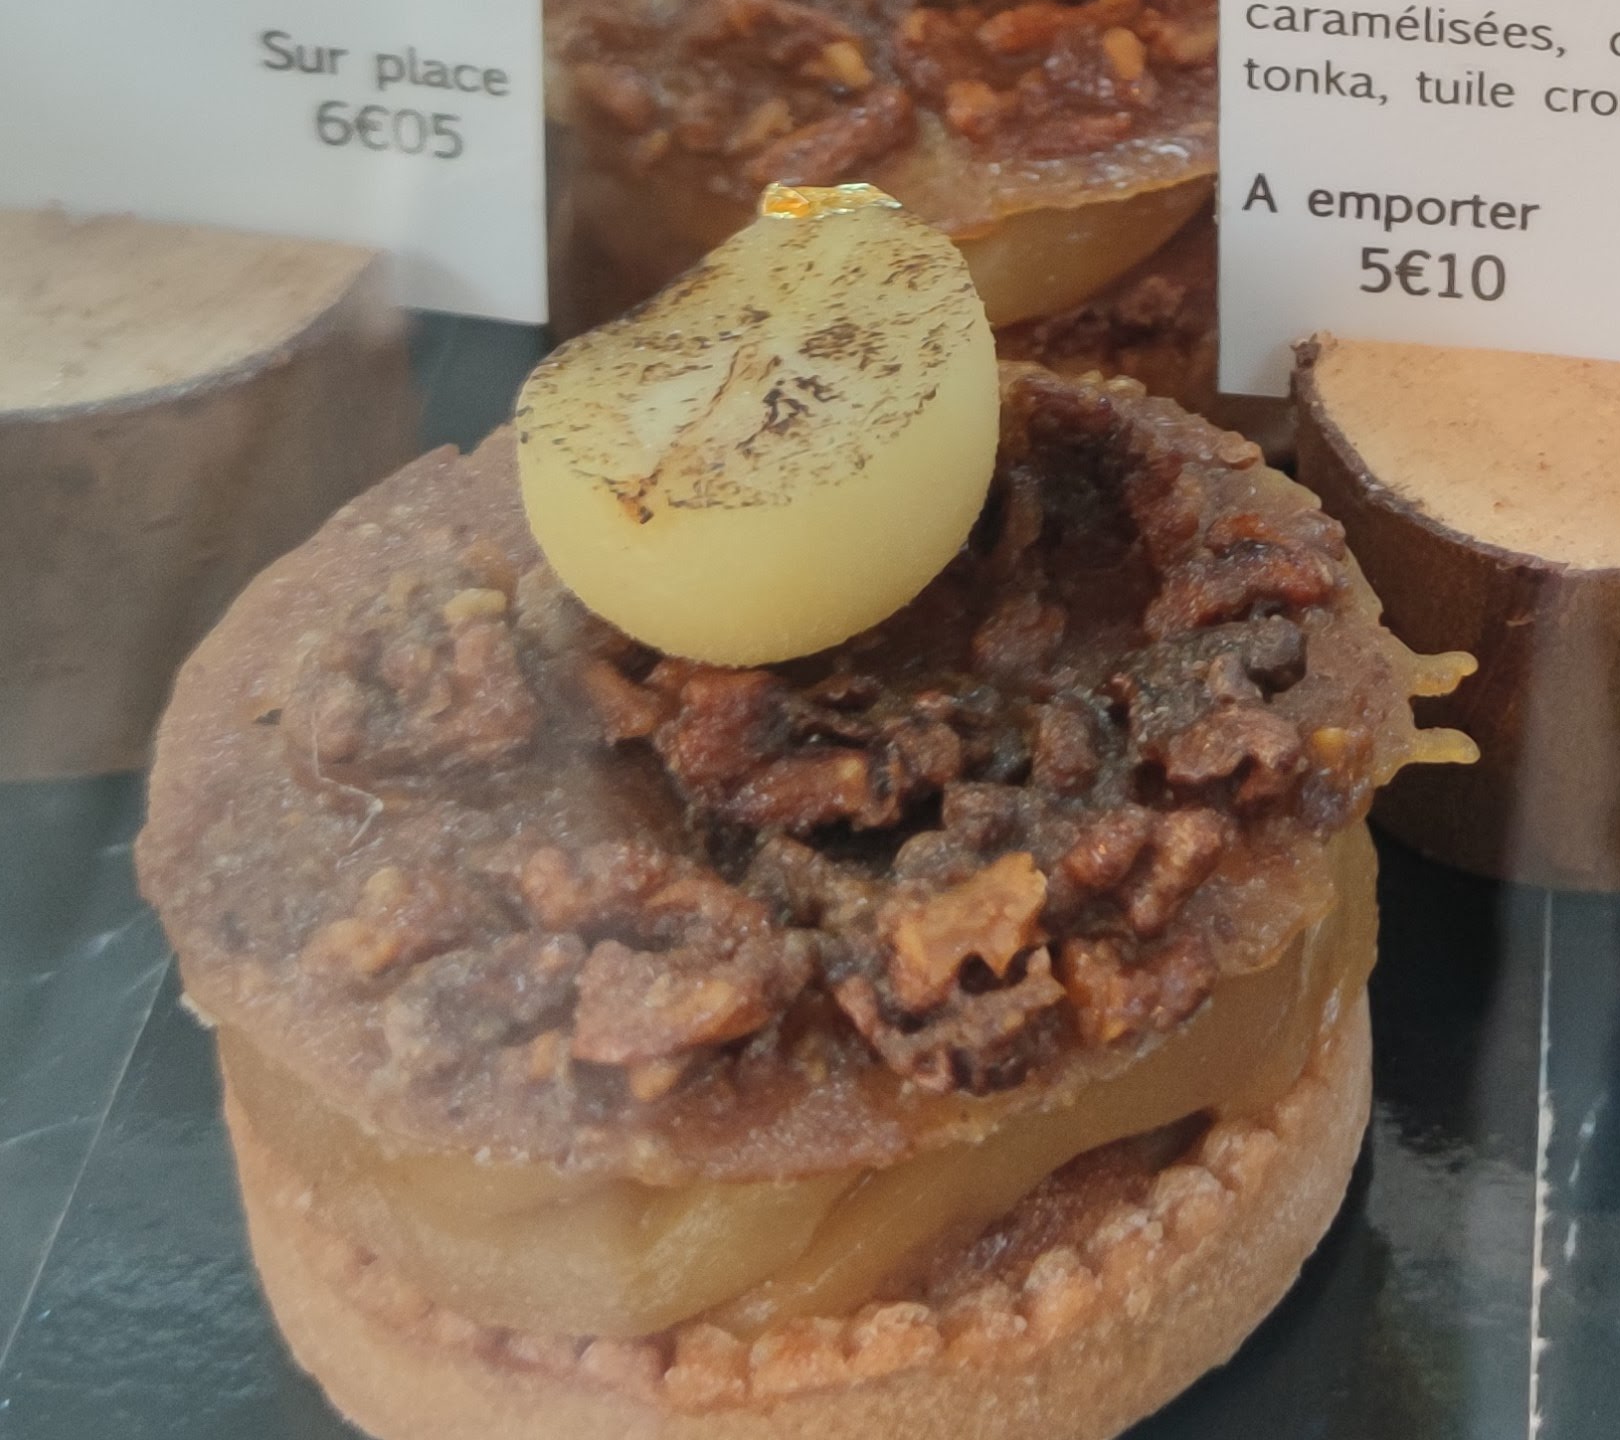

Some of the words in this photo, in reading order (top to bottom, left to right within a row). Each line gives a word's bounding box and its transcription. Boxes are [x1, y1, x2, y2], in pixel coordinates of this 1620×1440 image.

[1245, 3, 1566, 58] caramélisées,
[259, 29, 347, 75] Sur
[373, 46, 509, 97] place
[1243, 58, 1388, 106] tonka,
[1415, 70, 1515, 109] tuile
[313, 99, 464, 160] 6€05
[1241, 172, 1278, 214] A
[1307, 188, 1540, 233] emporter
[1359, 246, 1506, 302] 5€10
